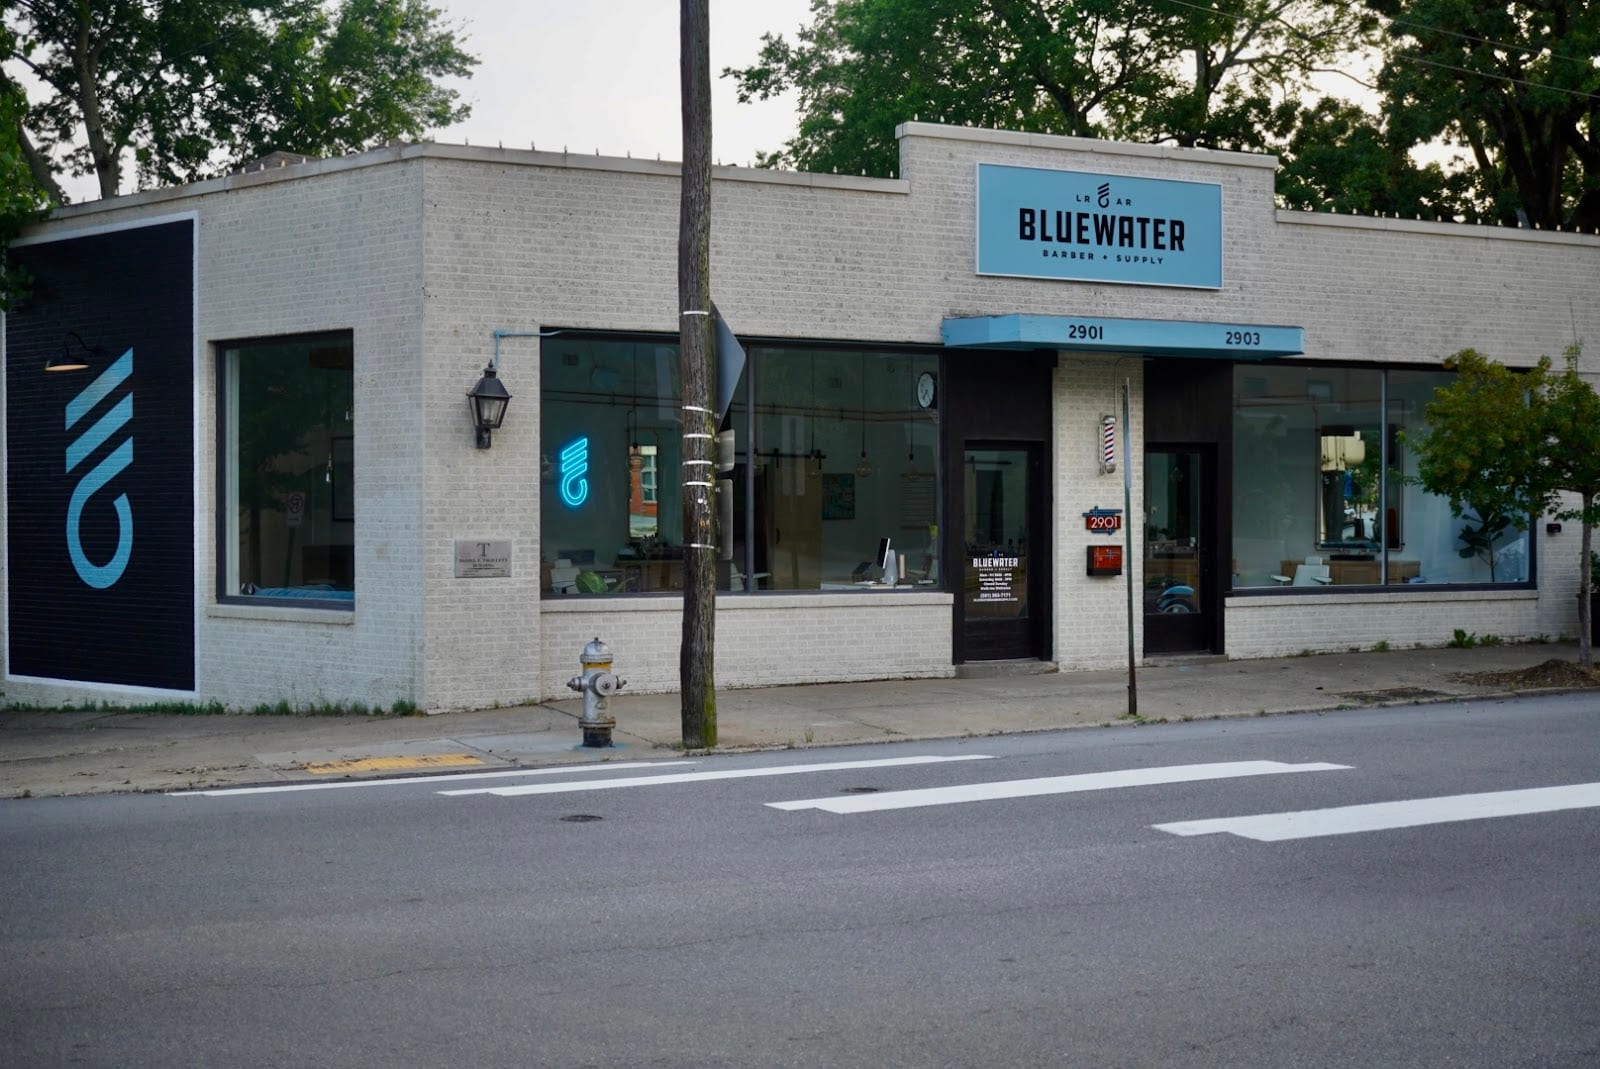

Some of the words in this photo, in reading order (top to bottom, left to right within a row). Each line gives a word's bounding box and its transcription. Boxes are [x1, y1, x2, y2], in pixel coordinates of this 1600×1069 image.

[1076, 194, 1090, 203] LR
[1116, 198, 1132, 206] AR
[1019, 208, 1185, 251] BLUEWATER
[1042, 249, 1094, 260] BARBER
[1116, 254, 1163, 264] SUPPLY
[1068, 325, 1103, 340] 2901
[1225, 331, 1261, 346] 2903
[1091, 516, 1118, 529] 2901
[973, 557, 1018, 568] BLUEWATER
